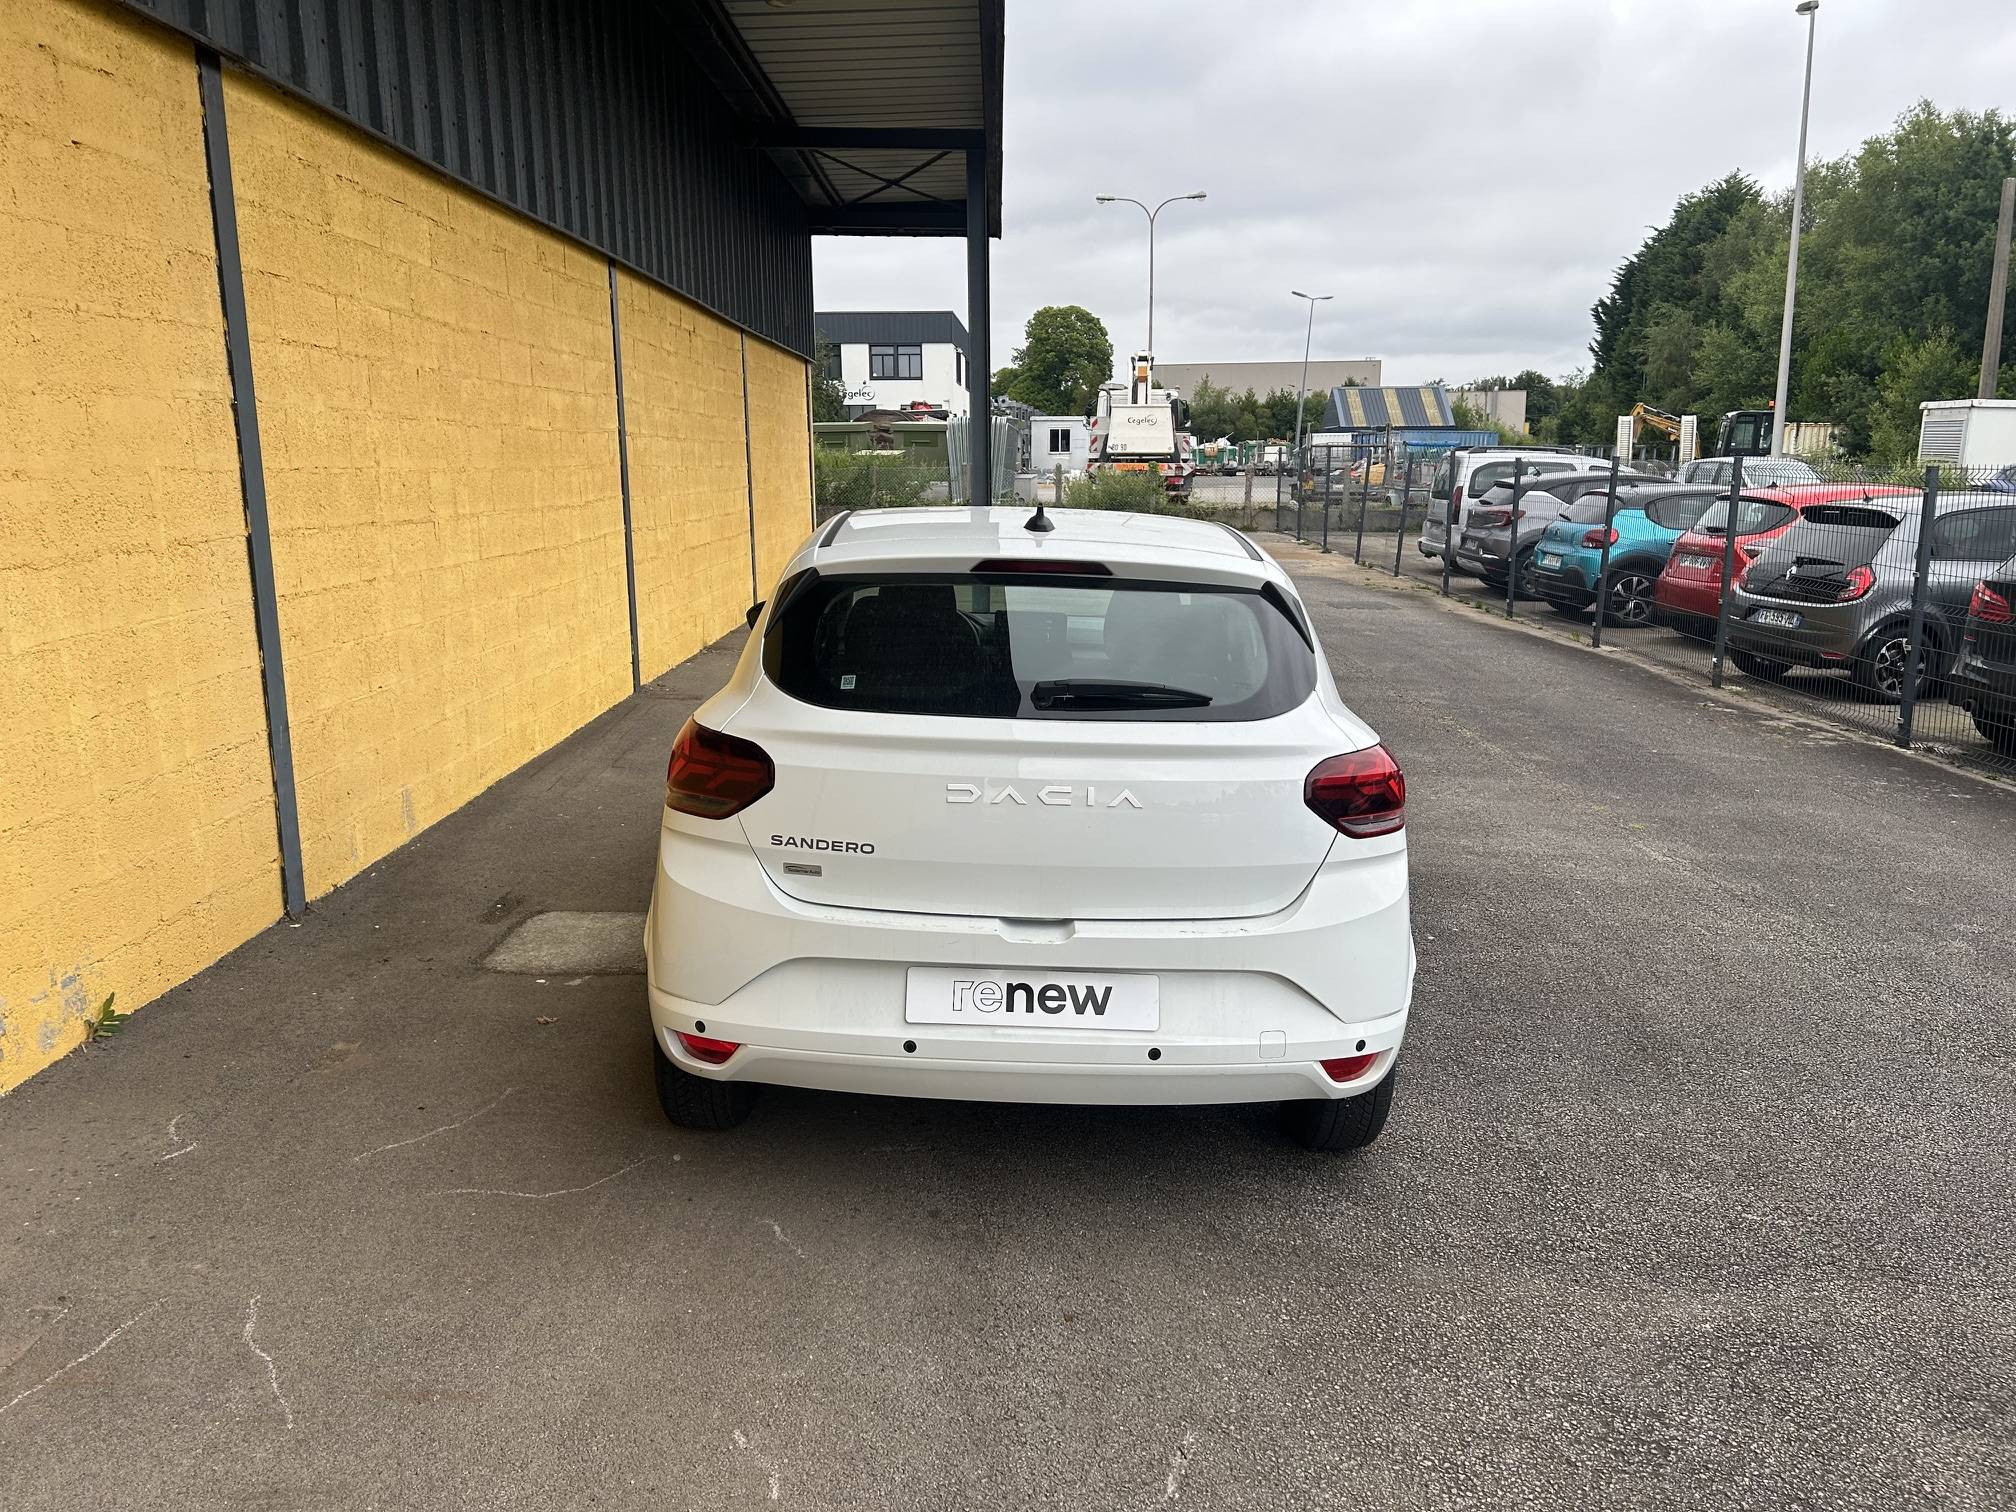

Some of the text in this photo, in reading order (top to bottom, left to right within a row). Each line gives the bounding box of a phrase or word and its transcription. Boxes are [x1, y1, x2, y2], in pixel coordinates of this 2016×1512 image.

[1127, 415, 1158, 426] Cegelec
[946, 783, 1144, 809] DACIA
[770, 834, 875, 854] SANDERO
[952, 980, 1113, 1016] renew
